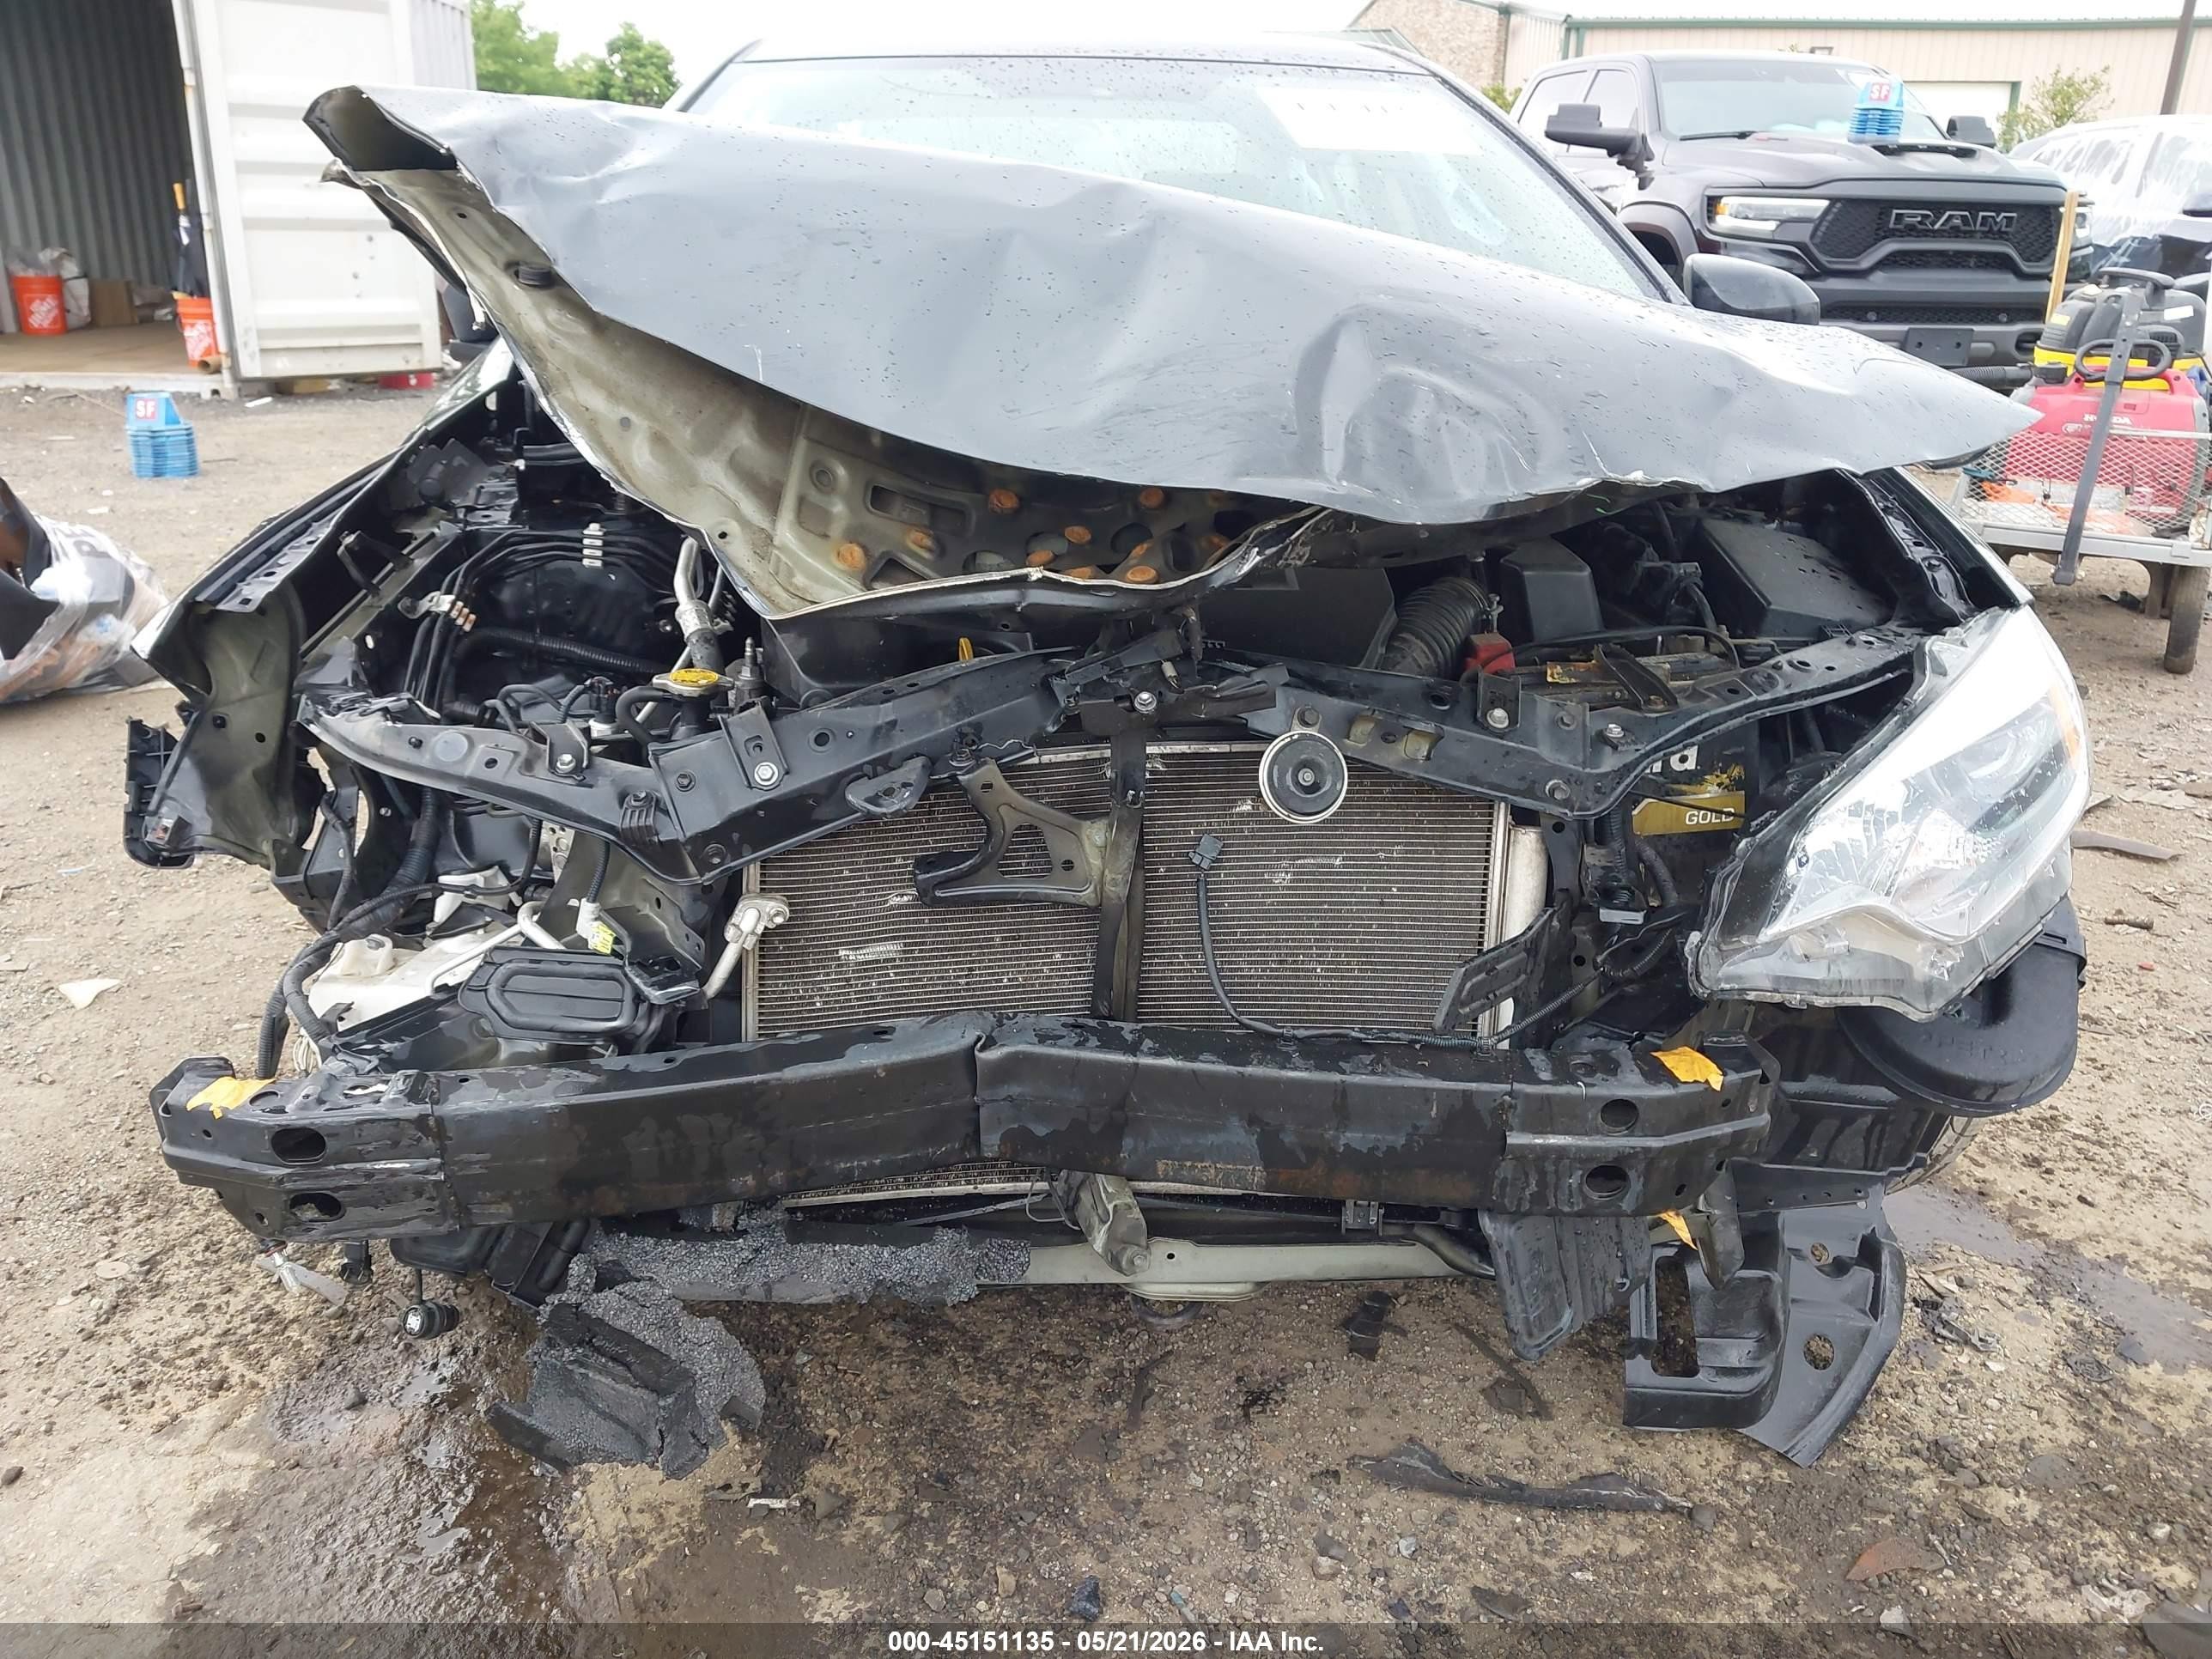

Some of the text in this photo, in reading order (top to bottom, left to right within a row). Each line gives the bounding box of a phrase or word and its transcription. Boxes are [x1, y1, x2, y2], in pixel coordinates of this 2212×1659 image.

[1889, 209, 2017, 233] RAM
[136, 400, 155, 418] SF
[1685, 807, 1735, 825] GOLD
